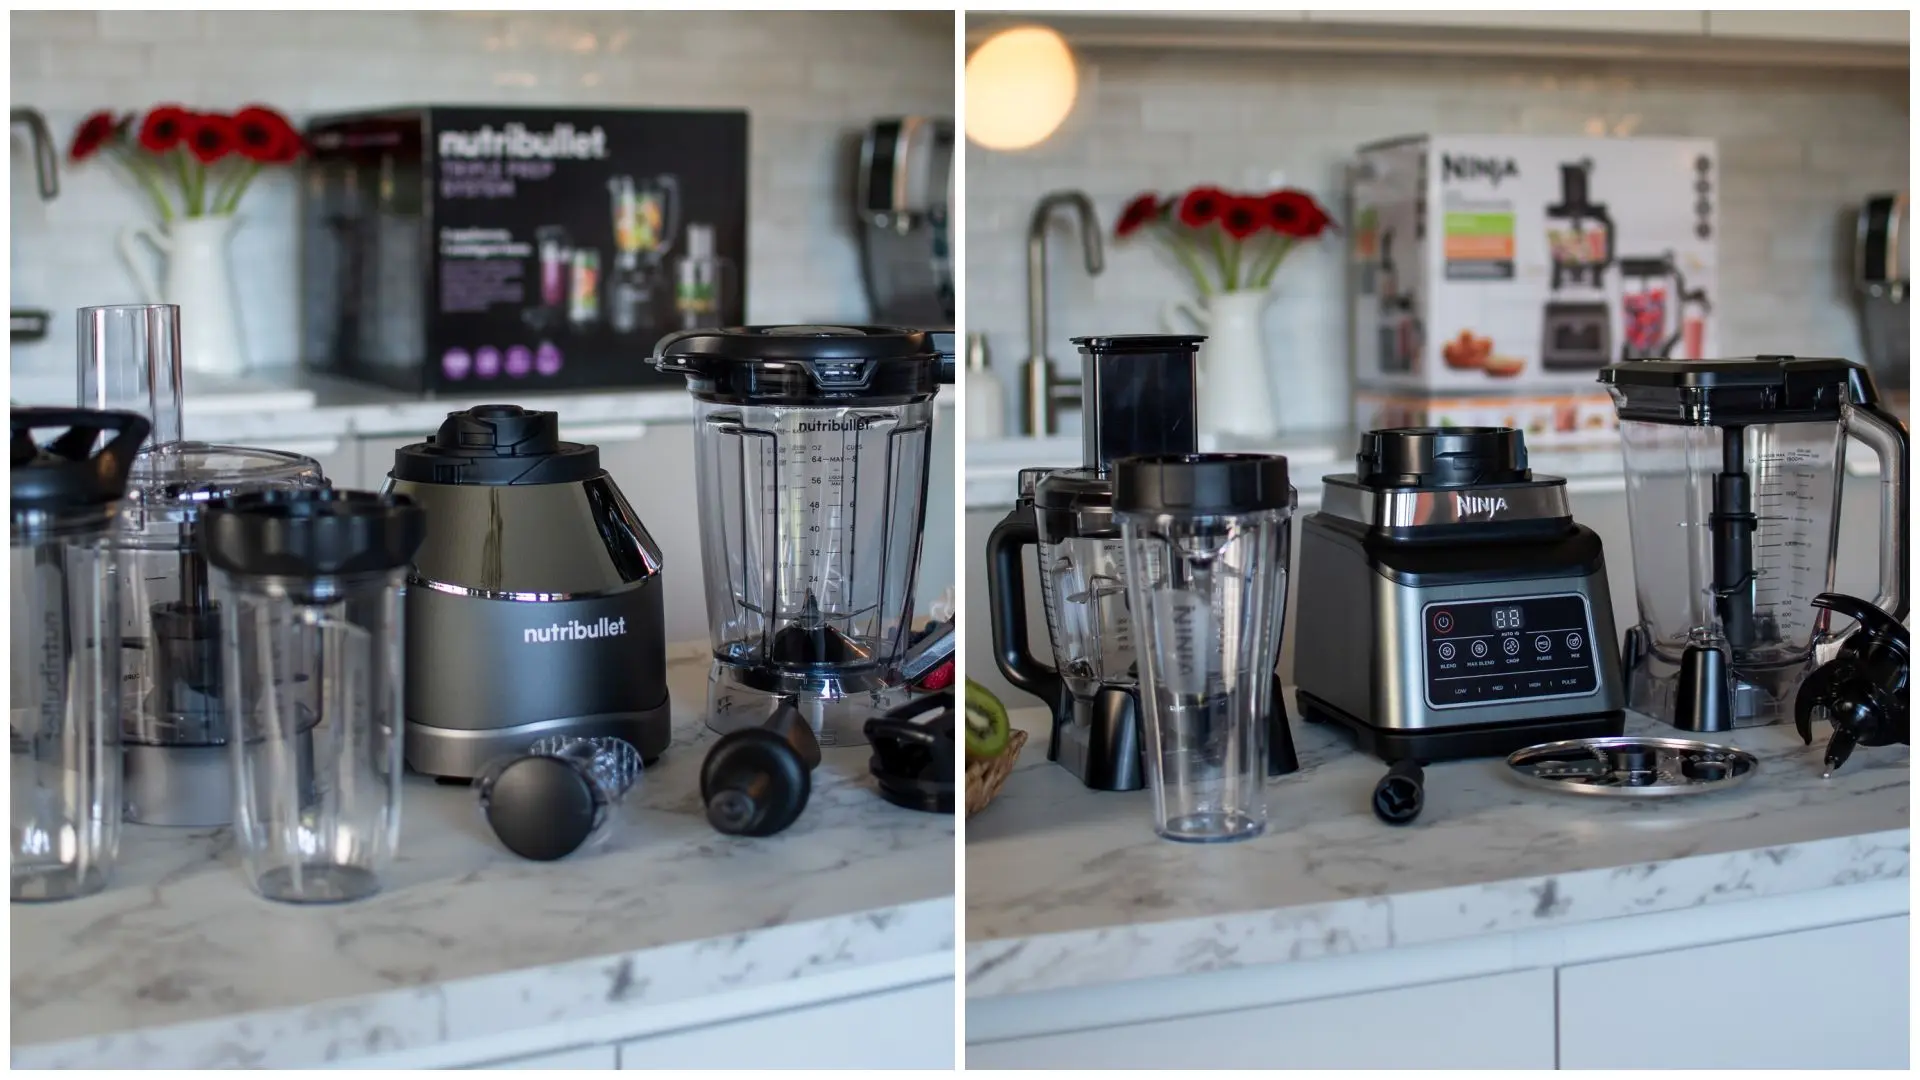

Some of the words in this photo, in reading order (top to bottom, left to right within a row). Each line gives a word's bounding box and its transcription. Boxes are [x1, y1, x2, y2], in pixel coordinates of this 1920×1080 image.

[1443, 152, 1519, 187] NINJA
[811, 477, 822, 485] 56
[1456, 495, 1508, 518] NINJA
[808, 575, 818, 583] 24
[1495, 609, 1520, 628] 88
